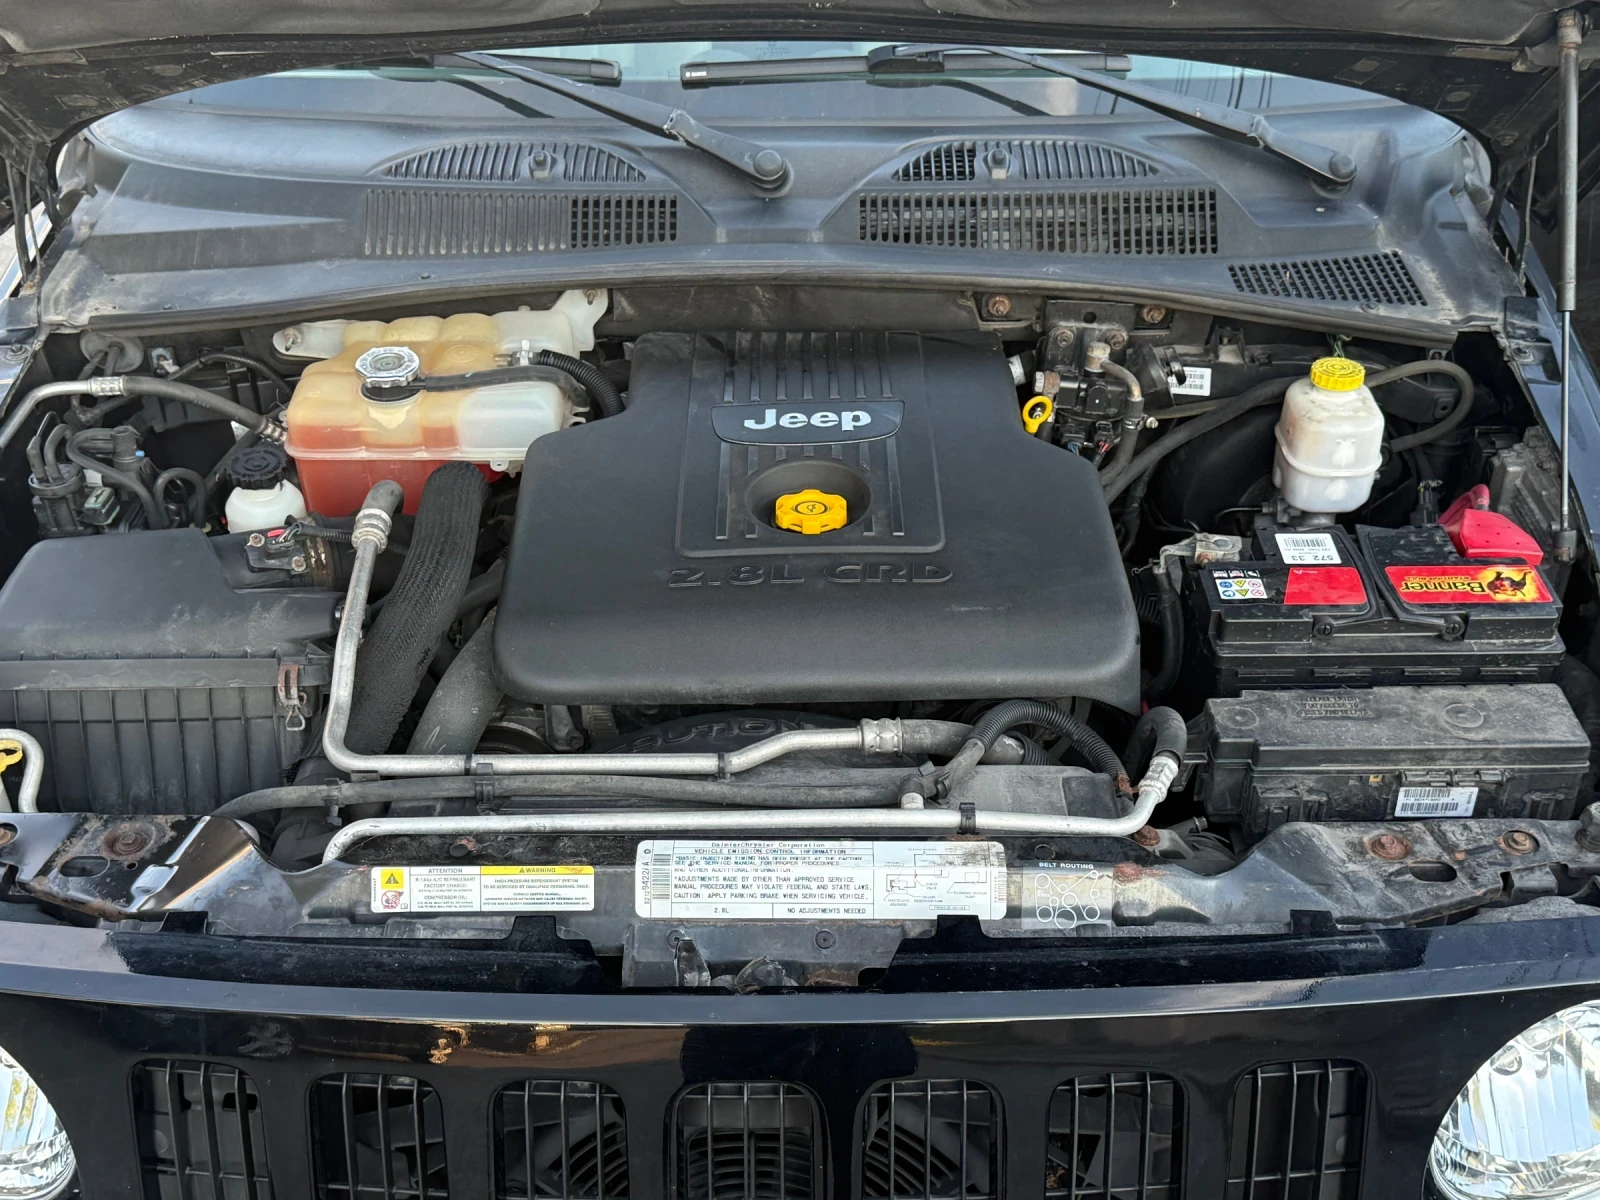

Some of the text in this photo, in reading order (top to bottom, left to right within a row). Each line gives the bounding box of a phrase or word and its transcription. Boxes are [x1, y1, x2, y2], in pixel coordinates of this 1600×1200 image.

[743, 408, 872, 431] Jeep
[668, 562, 953, 588] 2.8L CRD
[1402, 582, 1487, 593] Banner
[606, 717, 802, 753] AUTION
